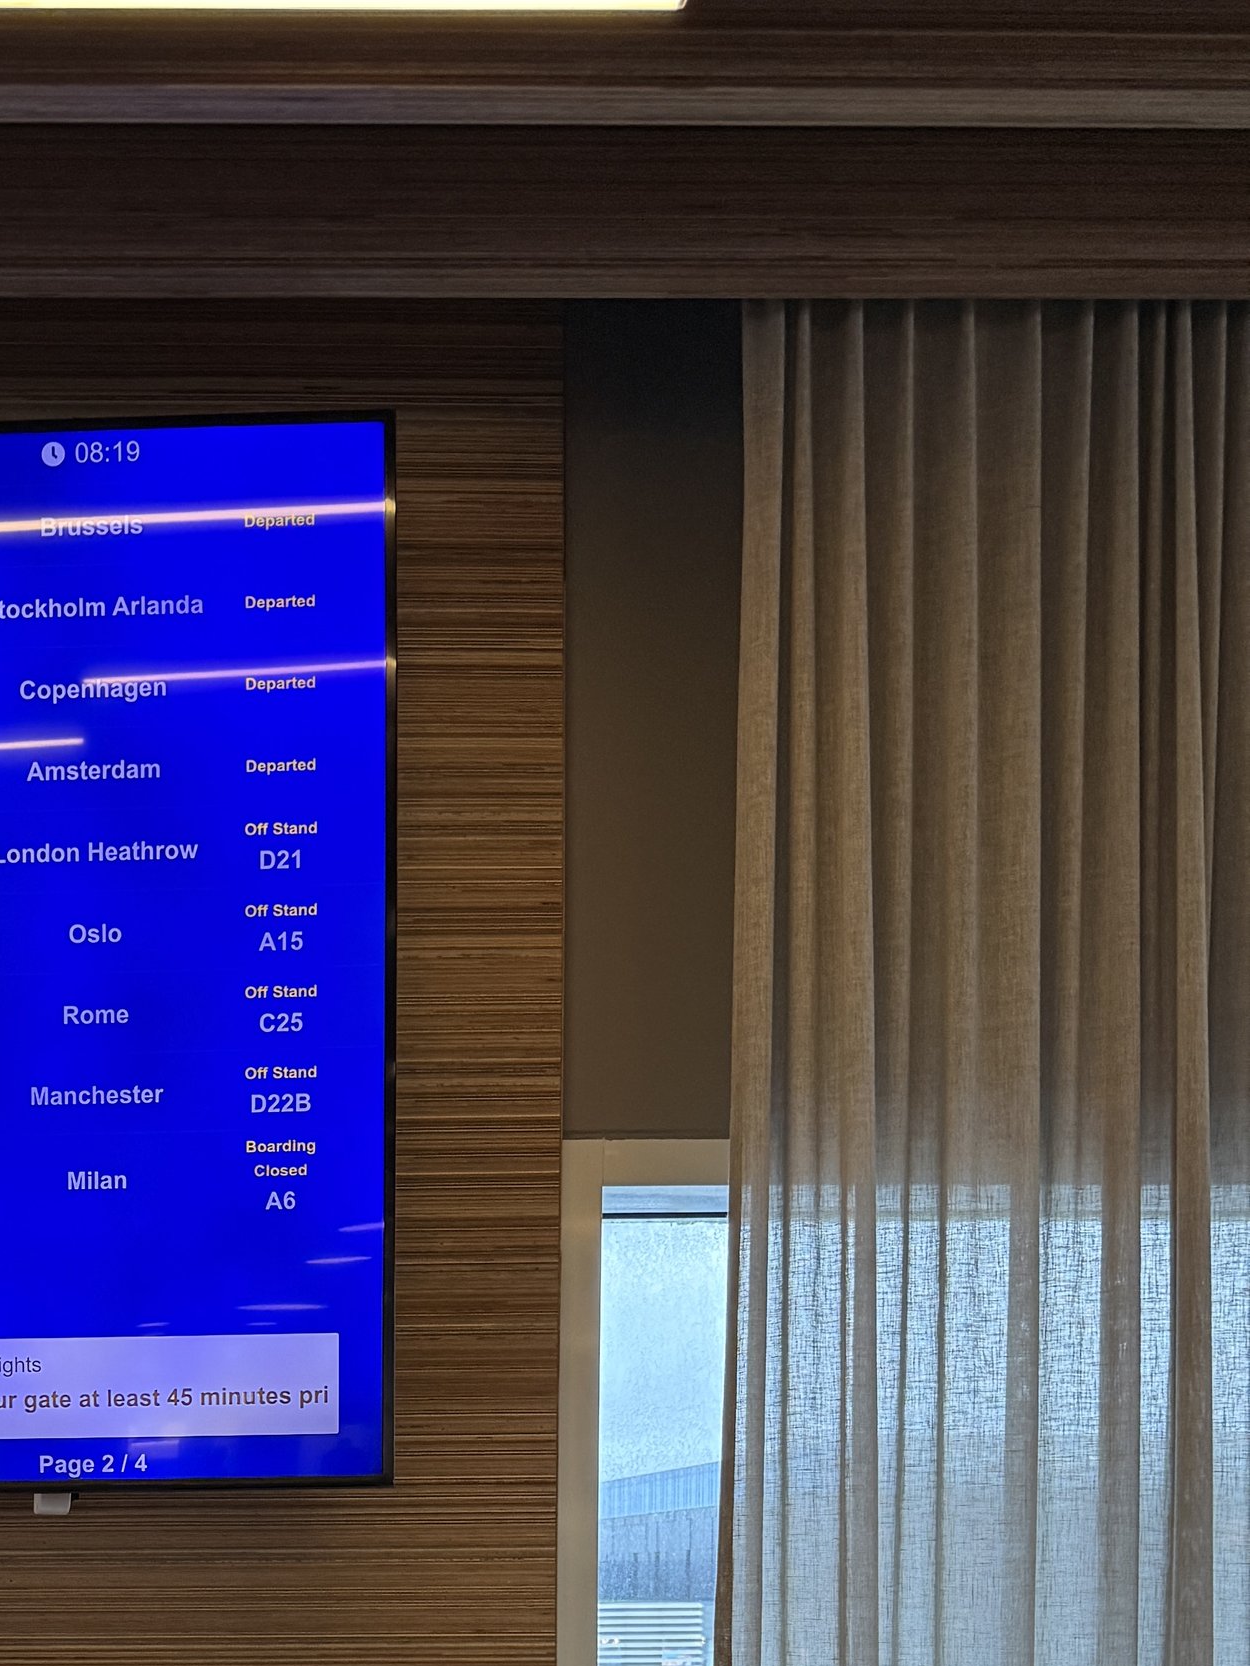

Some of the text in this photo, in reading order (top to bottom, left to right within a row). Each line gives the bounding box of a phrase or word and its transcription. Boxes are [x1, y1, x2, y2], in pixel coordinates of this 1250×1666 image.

[75, 440, 140, 464] 08:19
[39, 514, 144, 539] Brussels
[244, 513, 315, 530] Departed
[112, 594, 204, 616] Arlanda
[244, 594, 316, 612] Departed
[19, 679, 167, 704] Copenhagen
[245, 675, 316, 692] Departed
[26, 759, 161, 782] Amsterdam
[245, 757, 317, 776] Departed
[244, 820, 318, 836] Off Stand
[88, 840, 199, 862] Heathrow
[259, 849, 301, 870] D21
[244, 902, 318, 918] Off Stand
[68, 923, 122, 944] Oslo
[258, 930, 304, 952] A15
[244, 984, 318, 999] Off Stand
[63, 1005, 129, 1025] Rome
[259, 1012, 304, 1033] C25
[244, 1065, 318, 1080] Off Stand
[30, 1085, 164, 1106] Manchester
[251, 1092, 312, 1114] D22B
[245, 1139, 316, 1155] Boarding
[253, 1163, 308, 1178] Closed
[67, 1170, 127, 1191] Milan
[265, 1190, 296, 1211] A6
[23, 1390, 71, 1413] gate
[78, 1389, 99, 1408] at
[106, 1388, 160, 1407] least
[166, 1387, 192, 1406] 45
[200, 1386, 291, 1405] minutes
[299, 1385, 328, 1408] pri
[39, 1453, 148, 1479] Page 2 / 4
